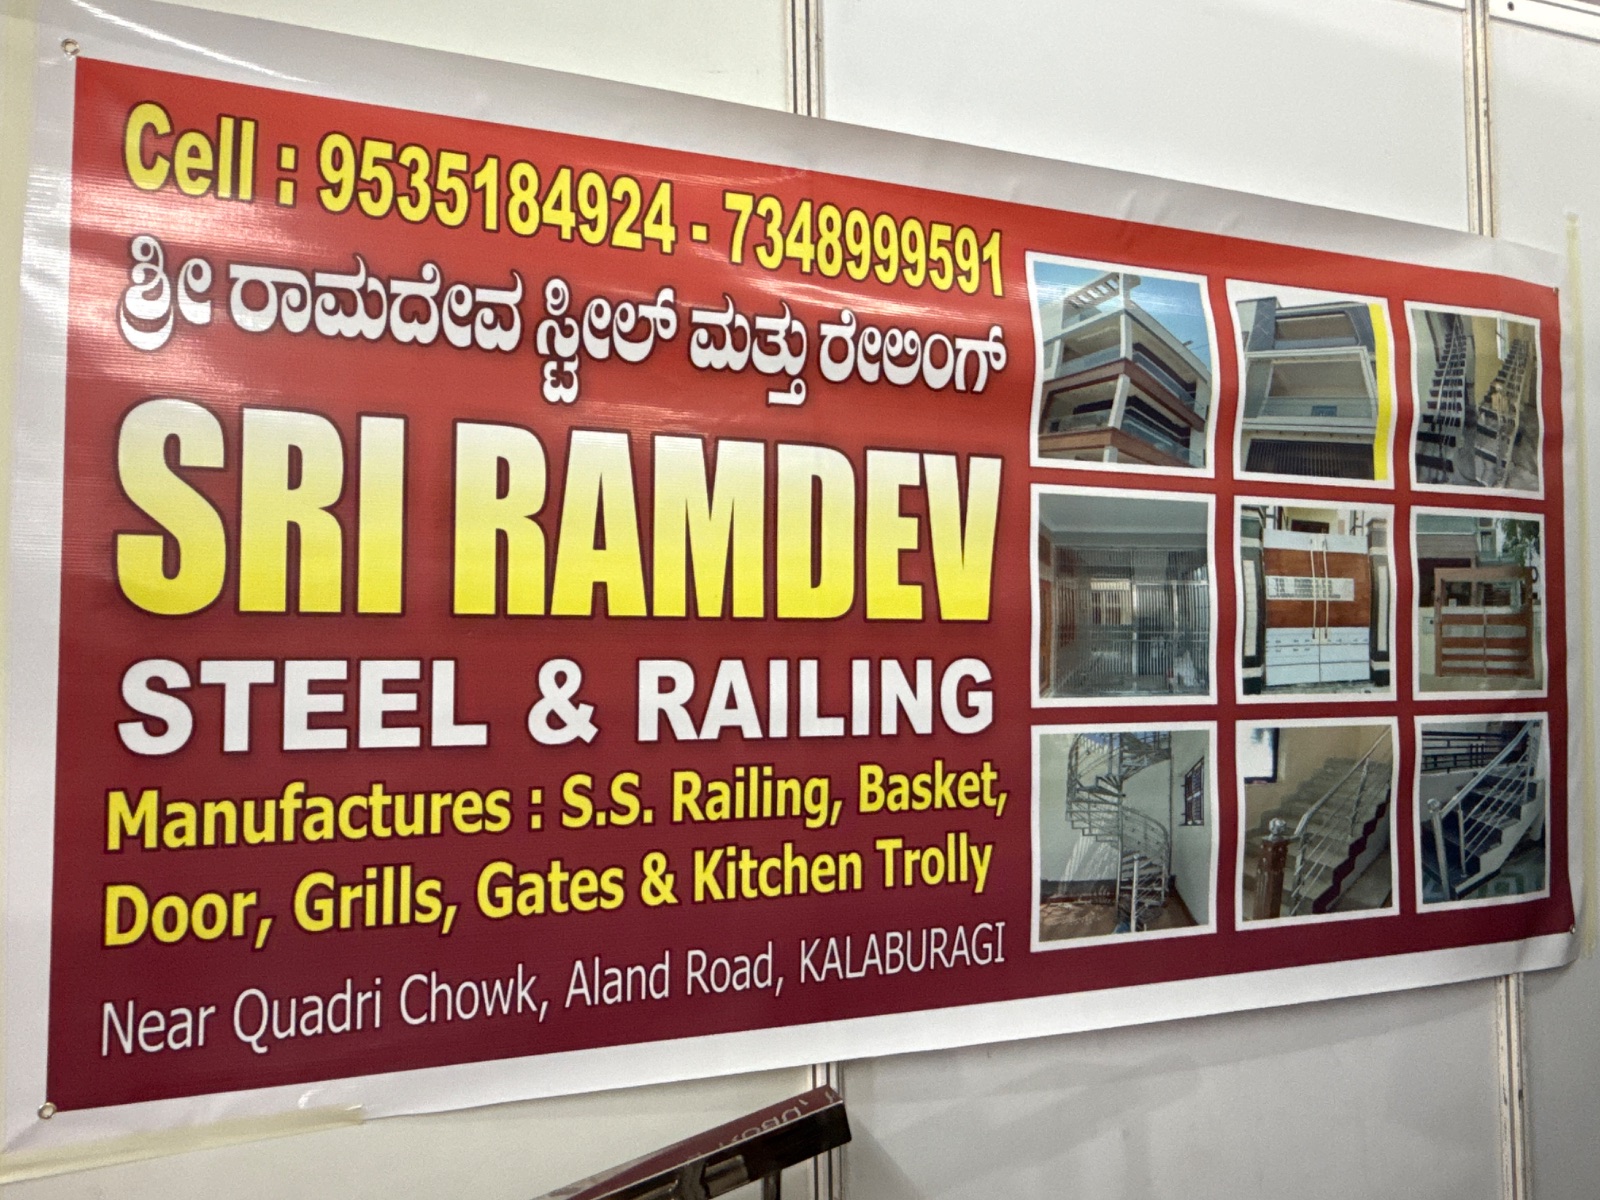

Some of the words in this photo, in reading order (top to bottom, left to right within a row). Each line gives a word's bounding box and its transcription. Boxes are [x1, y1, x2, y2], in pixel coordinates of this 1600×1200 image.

[124, 102, 257, 200] Cell
[319, 133, 676, 254] 9535184924
[724, 192, 1005, 297] 7348999591
[118, 235, 213, 351] ಶ್ರೀ
[229, 254, 524, 352] ರಾಮದೇವ
[536, 277, 678, 404] ಸ್ಟೀಲ್
[689, 294, 808, 406] ಮತ್ತು
[819, 309, 1007, 394] ರೇಲಿಂಗ್
[115, 398, 406, 616] SRI
[453, 420, 1002, 622] RAMDEV
[117, 658, 488, 755] STEEL
[528, 658, 599, 747] &
[637, 658, 995, 743] RAILING
[105, 781, 512, 851] Manufactures
[560, 771, 654, 829] S.S.
[672, 765, 844, 829] Railing,
[858, 759, 1008, 817] Basket,
[103, 884, 275, 949] Door,
[293, 865, 458, 935] Grills,
[476, 860, 625, 919] Gates
[640, 851, 678, 906] &
[694, 842, 862, 902] Kitchen
[875, 832, 993, 893] Trolly
[100, 999, 216, 1057] Near
[233, 977, 382, 1054] Quadri
[400, 962, 549, 1023] Chowk,
[565, 950, 670, 1008] Aland
[686, 941, 784, 997] Road,
[799, 921, 1006, 983] KALABURAGI
